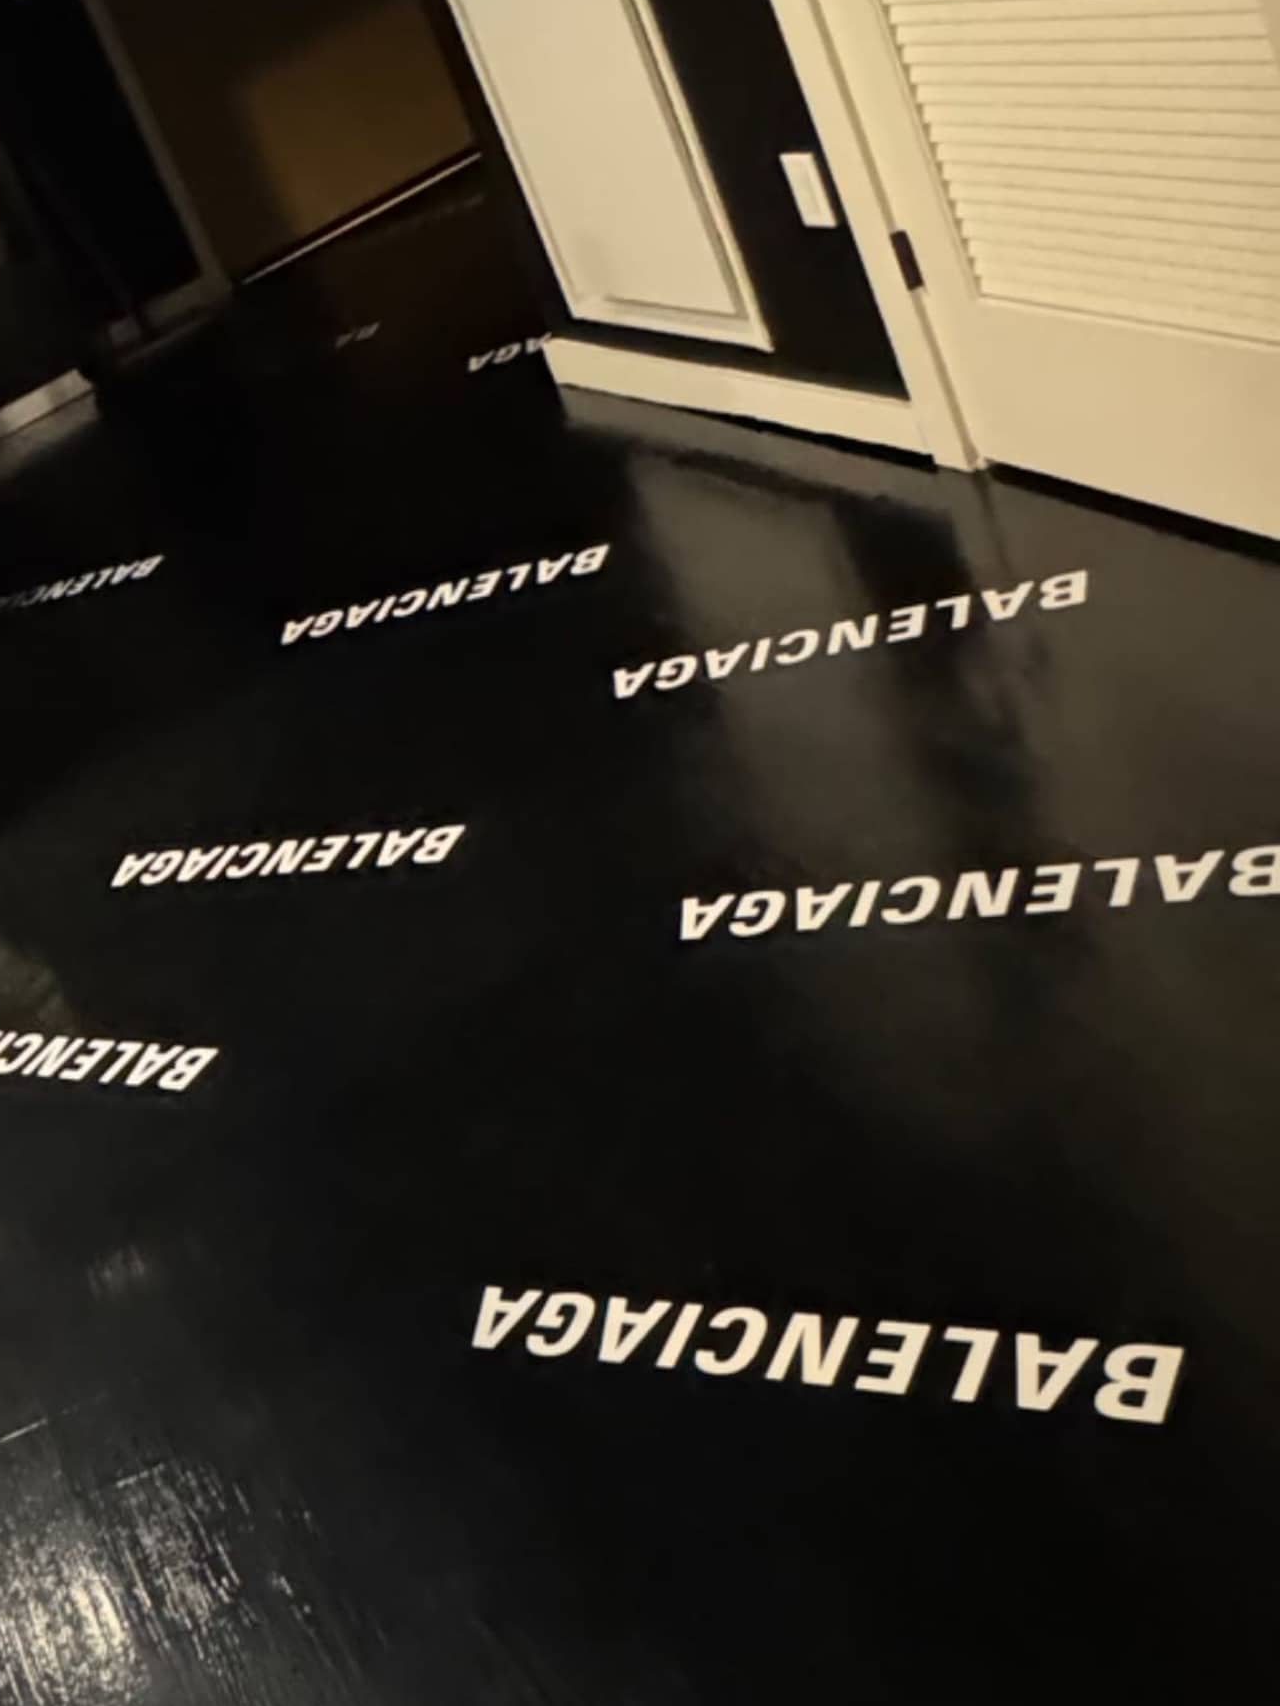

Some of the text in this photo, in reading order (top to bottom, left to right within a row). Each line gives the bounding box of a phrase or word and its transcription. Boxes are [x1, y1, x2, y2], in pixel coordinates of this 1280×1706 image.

[277, 542, 611, 647] BALENCIAGA
[610, 569, 1090, 701] BALENCIAGA
[109, 822, 468, 890] BALENCIAGA
[470, 1284, 1186, 1426] BALENCIAGA
